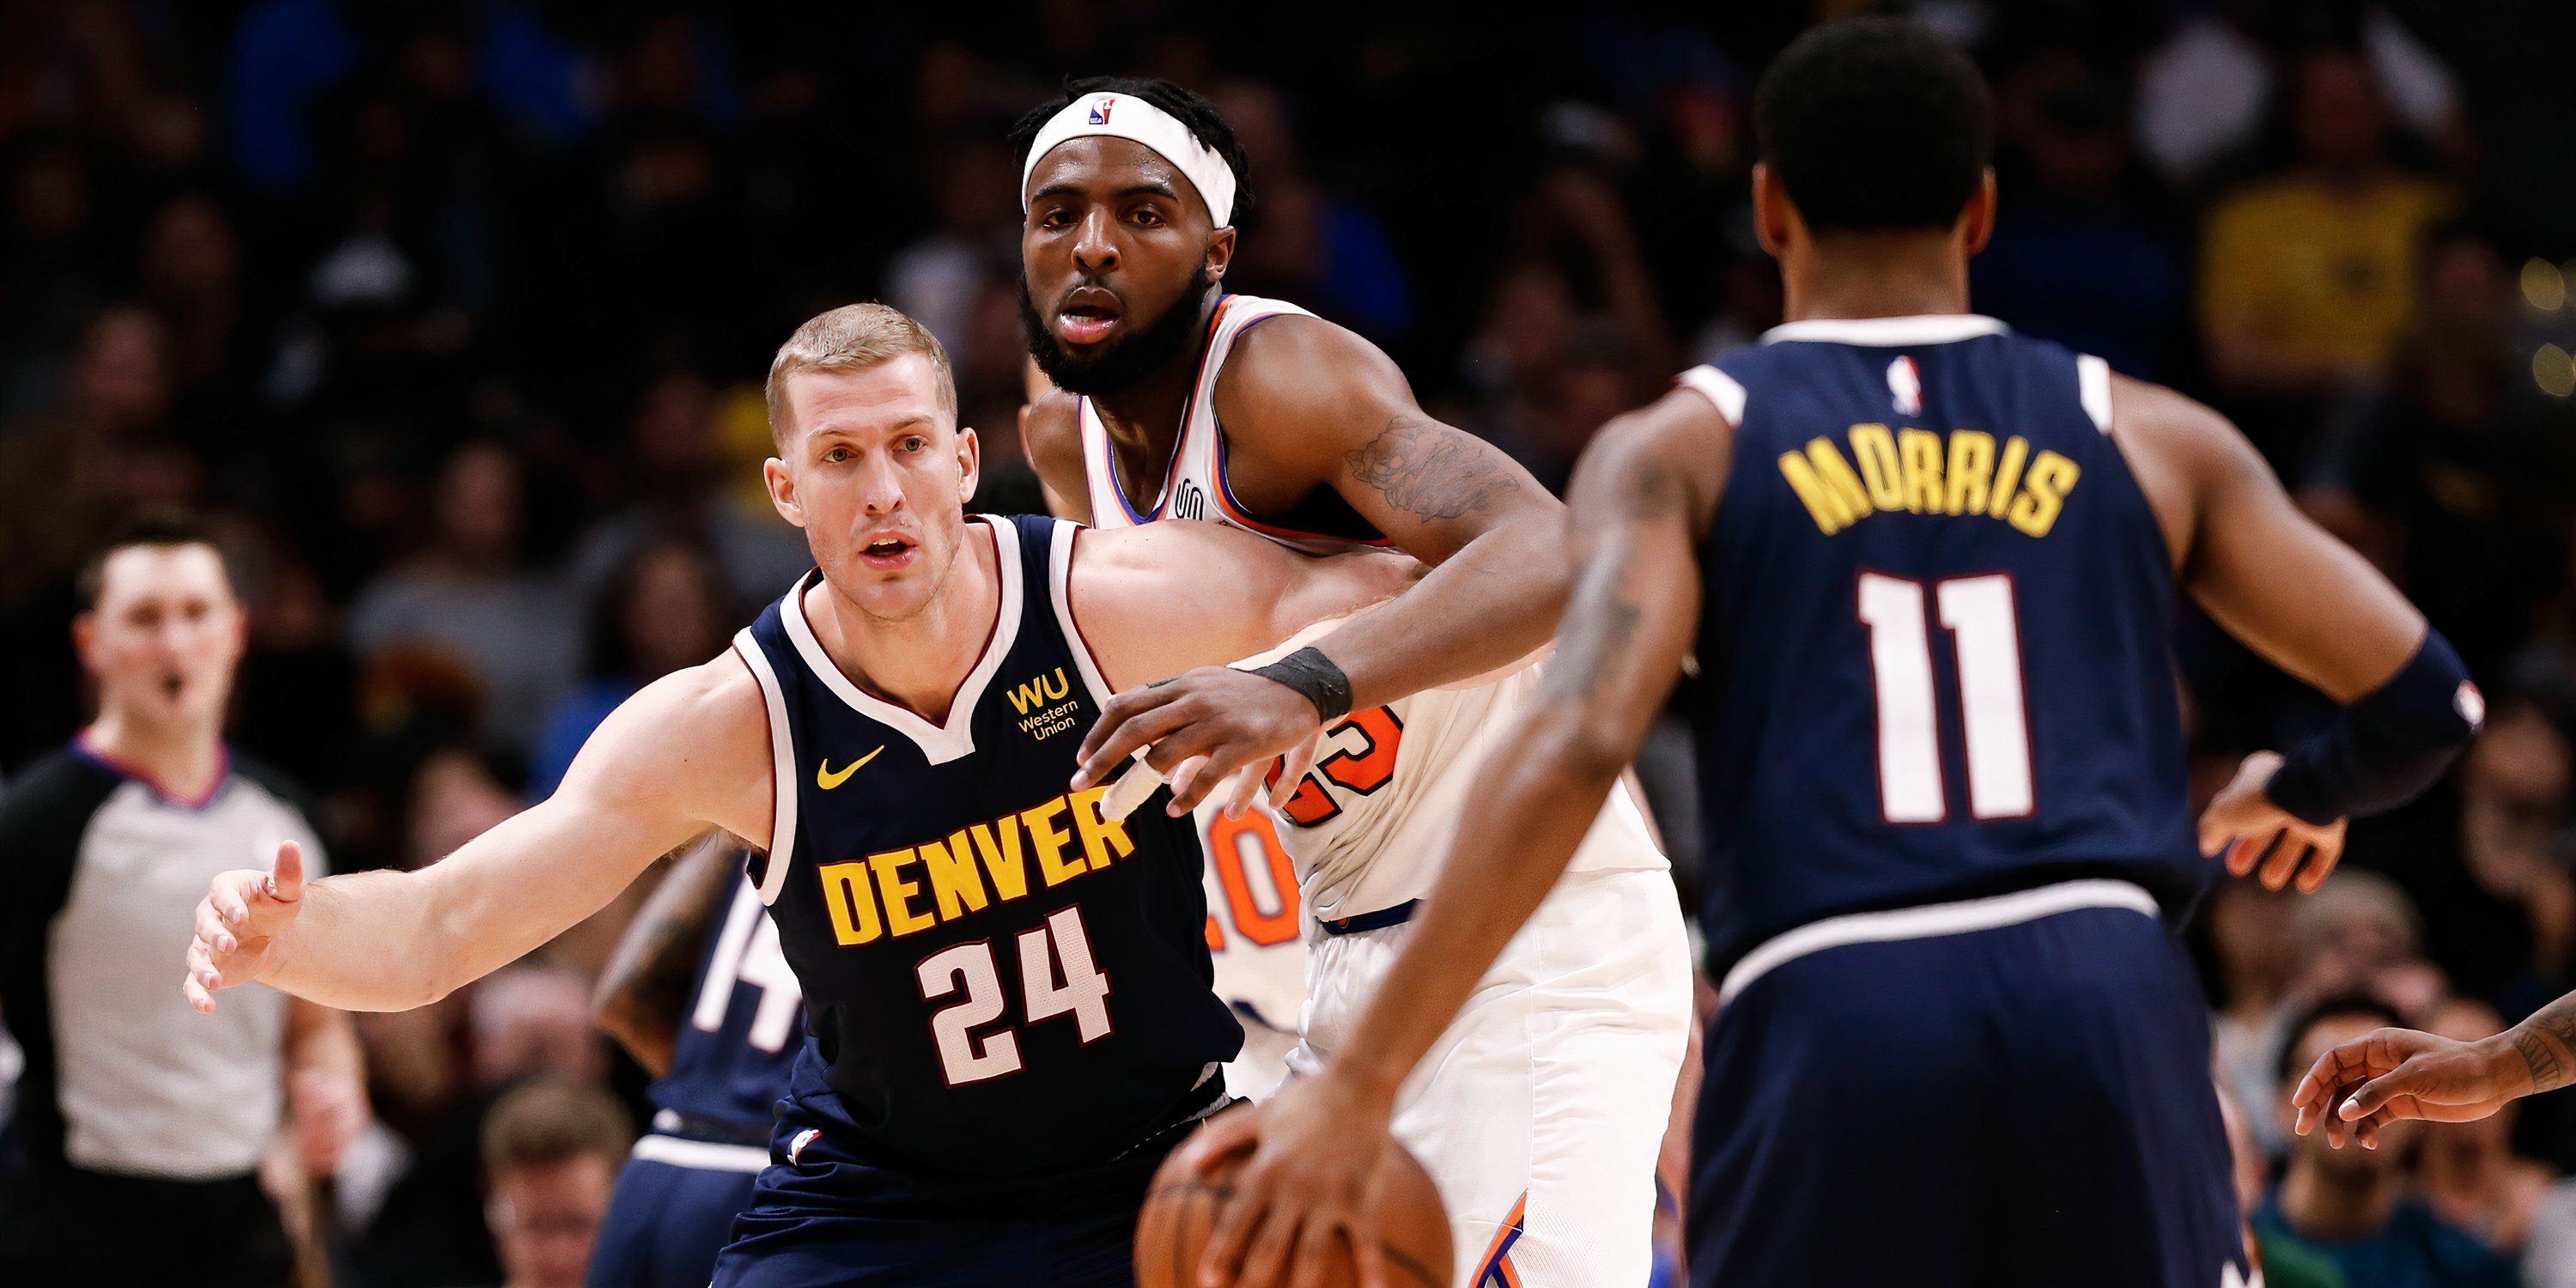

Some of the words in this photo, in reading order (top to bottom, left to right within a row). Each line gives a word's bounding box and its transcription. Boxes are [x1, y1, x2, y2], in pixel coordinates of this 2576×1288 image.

[1777, 422, 2081, 538] MORRIS
[1006, 667, 1069, 714] WU
[1018, 701, 1078, 732] Western
[1033, 717, 1075, 740] Union
[1856, 567, 2038, 824] 11
[817, 785, 1136, 947] DENVER
[1205, 805, 1302, 953] 0
[914, 903, 1115, 1088] 24
